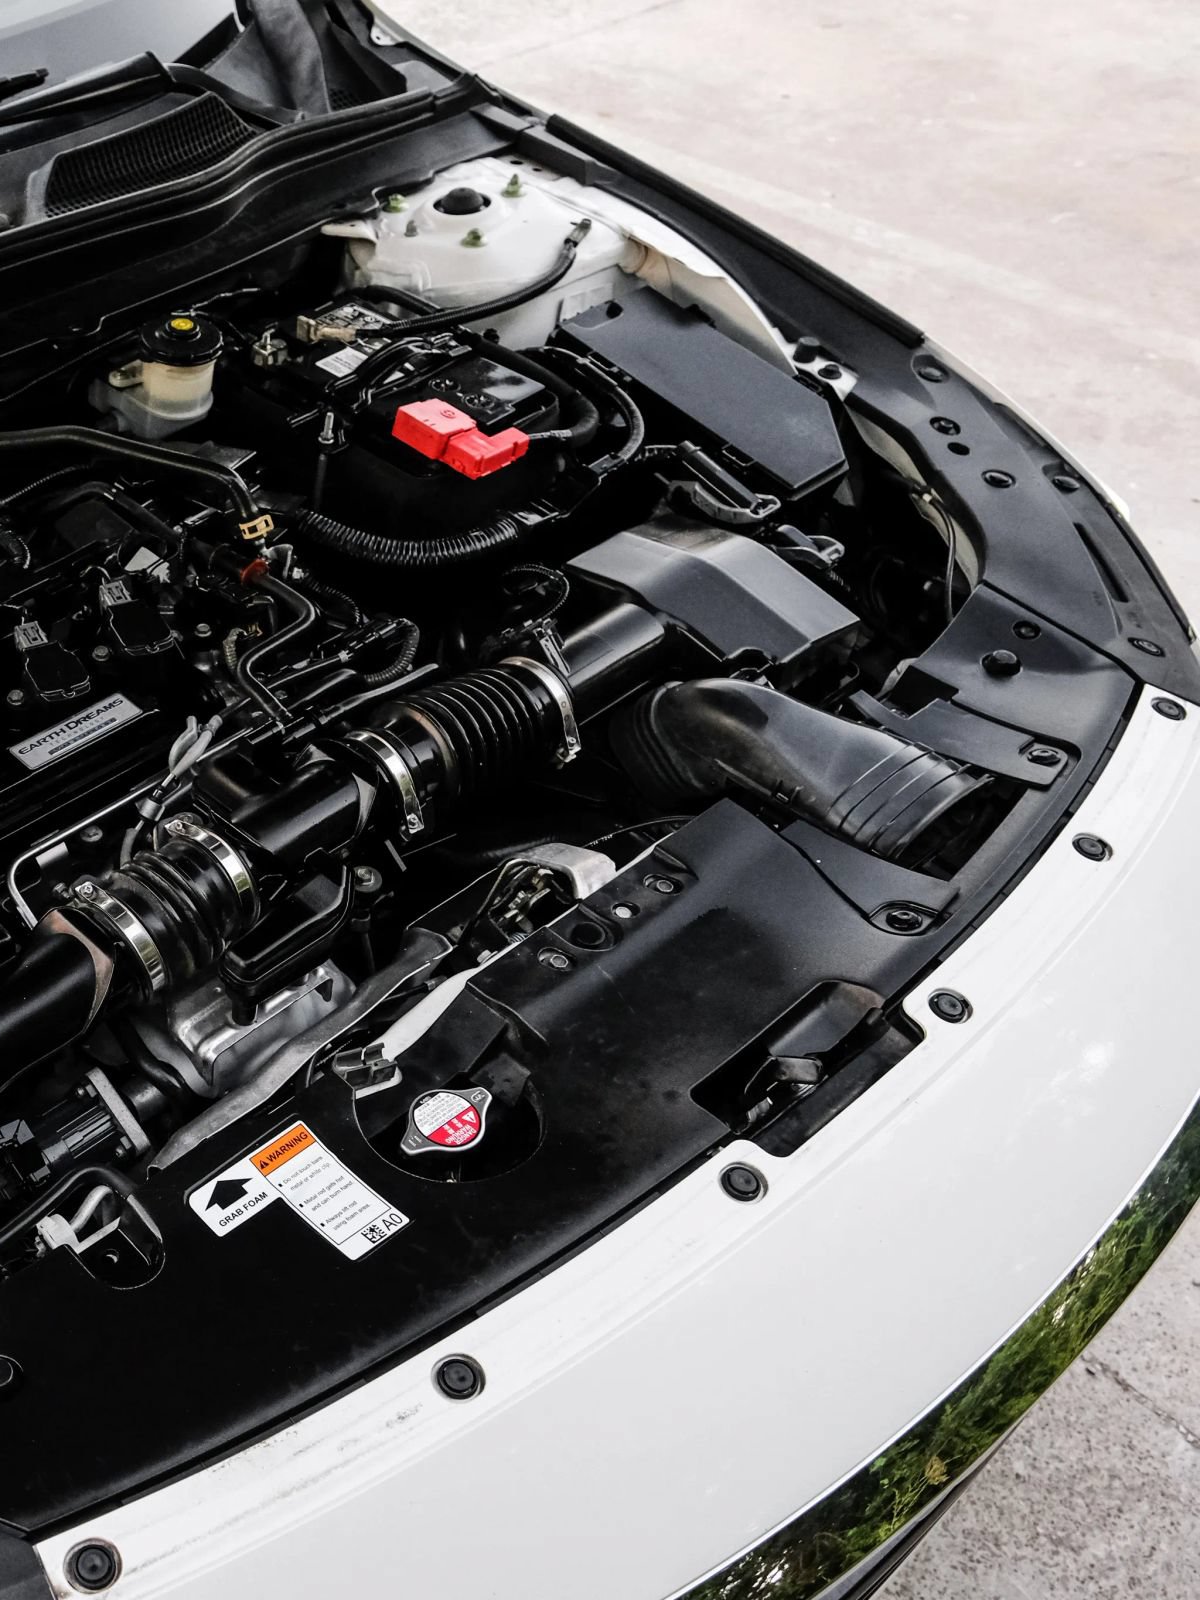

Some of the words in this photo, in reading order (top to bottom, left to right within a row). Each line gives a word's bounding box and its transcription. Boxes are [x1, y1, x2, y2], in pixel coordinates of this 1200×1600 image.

[18, 728, 67, 755] EARTH
[64, 698, 123, 730] DREAMS
[266, 1131, 308, 1162] WARNING
[454, 1127, 476, 1144] DANGER
[282, 1177, 292, 1185] Do
[291, 1171, 299, 1180] not
[299, 1162, 312, 1174] touch
[290, 1179, 304, 1190] metal
[303, 1175, 309, 1183] or
[310, 1168, 322, 1179] white
[303, 1194, 318, 1205] Metal
[317, 1188, 326, 1197] rod
[325, 1181, 337, 1192] gets
[335, 1175, 344, 1185] hot
[311, 1202, 321, 1212] and
[320, 1197, 330, 1205] can
[329, 1188, 341, 1199] burn
[218, 1208, 244, 1227] GRAB
[244, 1191, 268, 1211] FOAM
[325, 1210, 343, 1224] Always
[341, 1205, 349, 1213] lift
[333, 1219, 347, 1231] using
[345, 1211, 359, 1222] foam
[382, 1213, 403, 1231] A0
